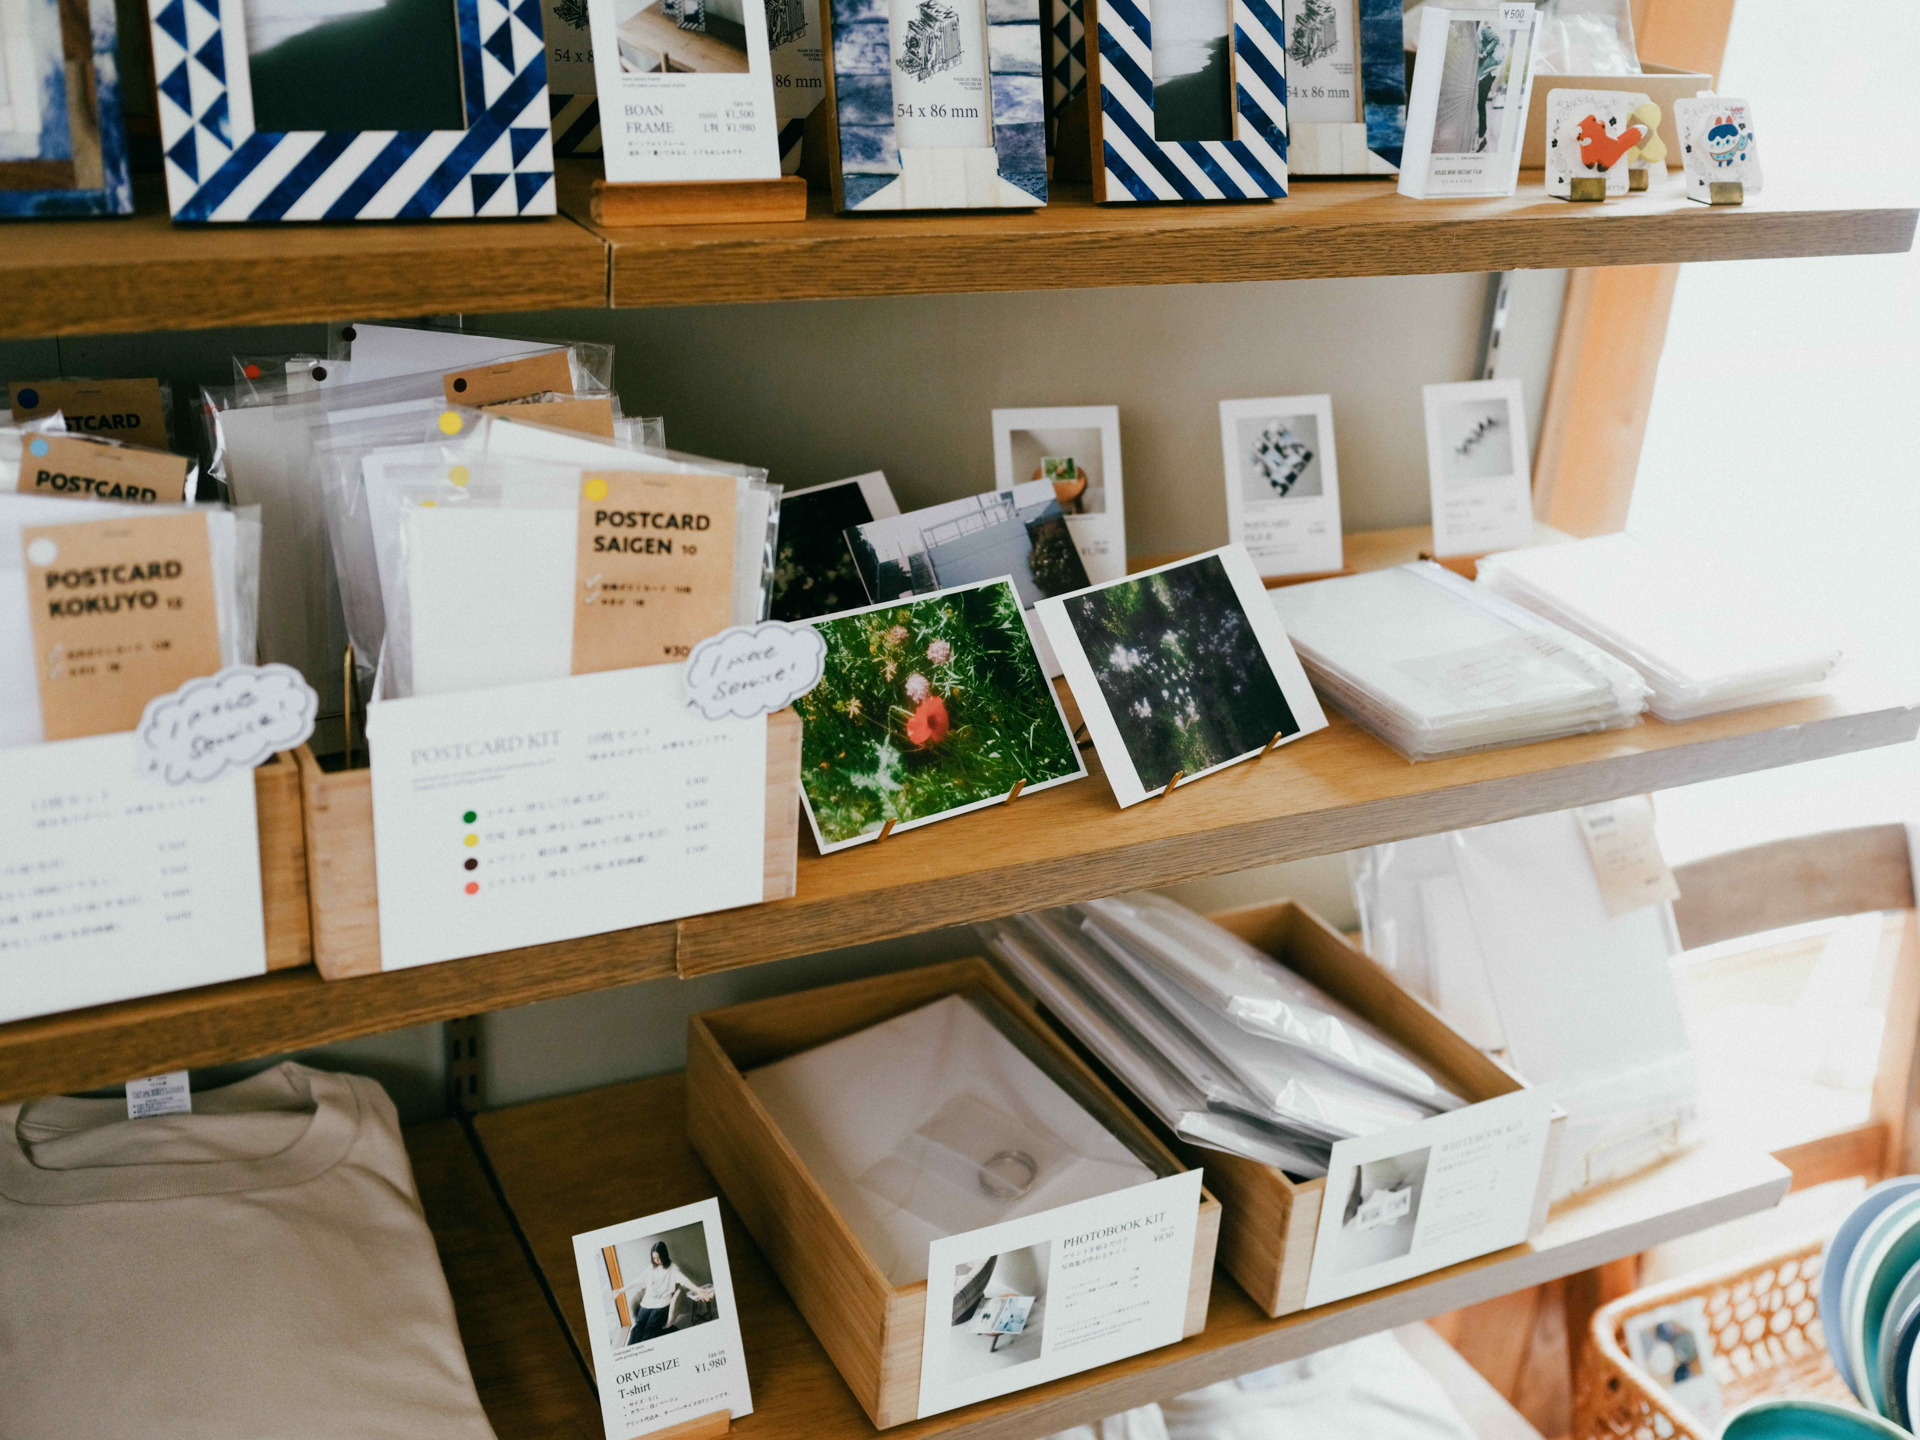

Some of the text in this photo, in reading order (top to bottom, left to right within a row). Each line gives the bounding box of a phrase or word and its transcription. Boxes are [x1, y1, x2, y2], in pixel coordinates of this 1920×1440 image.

[554, 48, 571, 62] 54
[574, 52, 584, 63] x
[775, 74, 823, 88] 86 mm
[1286, 85, 1350, 98] 54 x 86 mm
[624, 104, 664, 117] BOAN
[698, 109, 755, 120] mini ¥1,500
[897, 103, 979, 118] 54 x 86 mm
[625, 122, 675, 134] FRAME
[725, 122, 756, 133] ¥1,980
[67, 413, 141, 432] STCARD
[36, 469, 157, 501] POSTCARD
[593, 509, 711, 532] POSTCARD
[593, 536, 697, 556] SAIGEN 10
[46, 559, 183, 591] POSTCARD
[48, 590, 158, 620] KOKUYO
[410, 728, 562, 767] POSTCARD KIT
[1062, 1211, 1167, 1249] PHOTOBOOK KIT
[615, 1356, 727, 1385] ORVERSIZE ¥1,980
[617, 1382, 651, 1400] T-shirt
